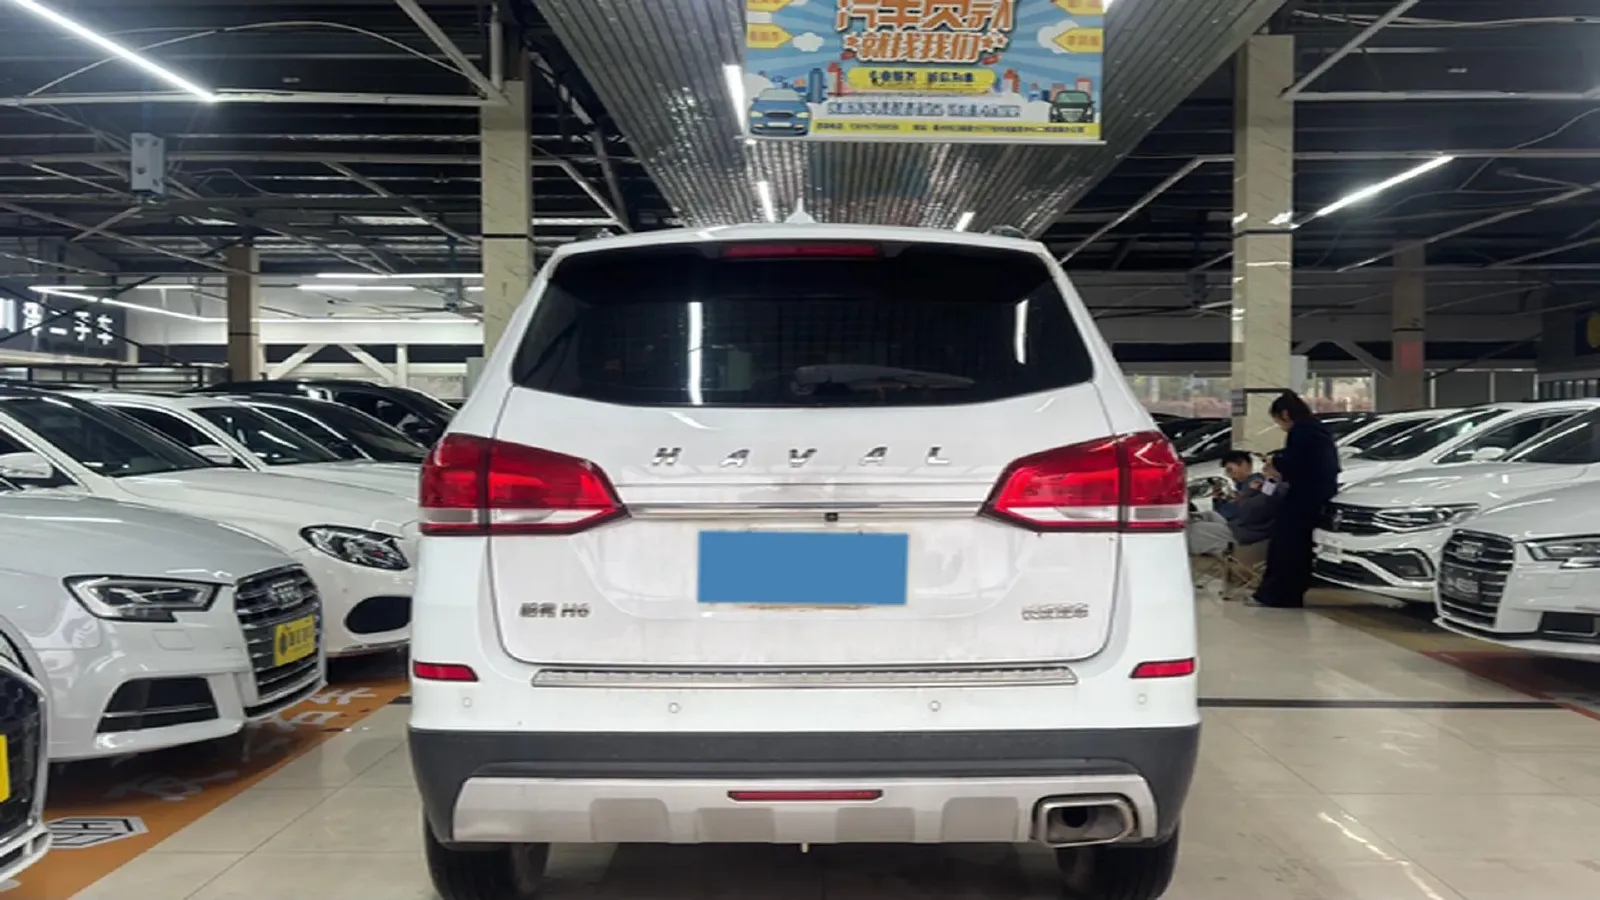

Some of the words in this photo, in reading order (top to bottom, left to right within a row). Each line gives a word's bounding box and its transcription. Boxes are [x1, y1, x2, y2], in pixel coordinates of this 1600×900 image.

[861, 32, 982, 62] 就找我们
[651, 446, 953, 468] HAVAL
[560, 602, 590, 618] H6
